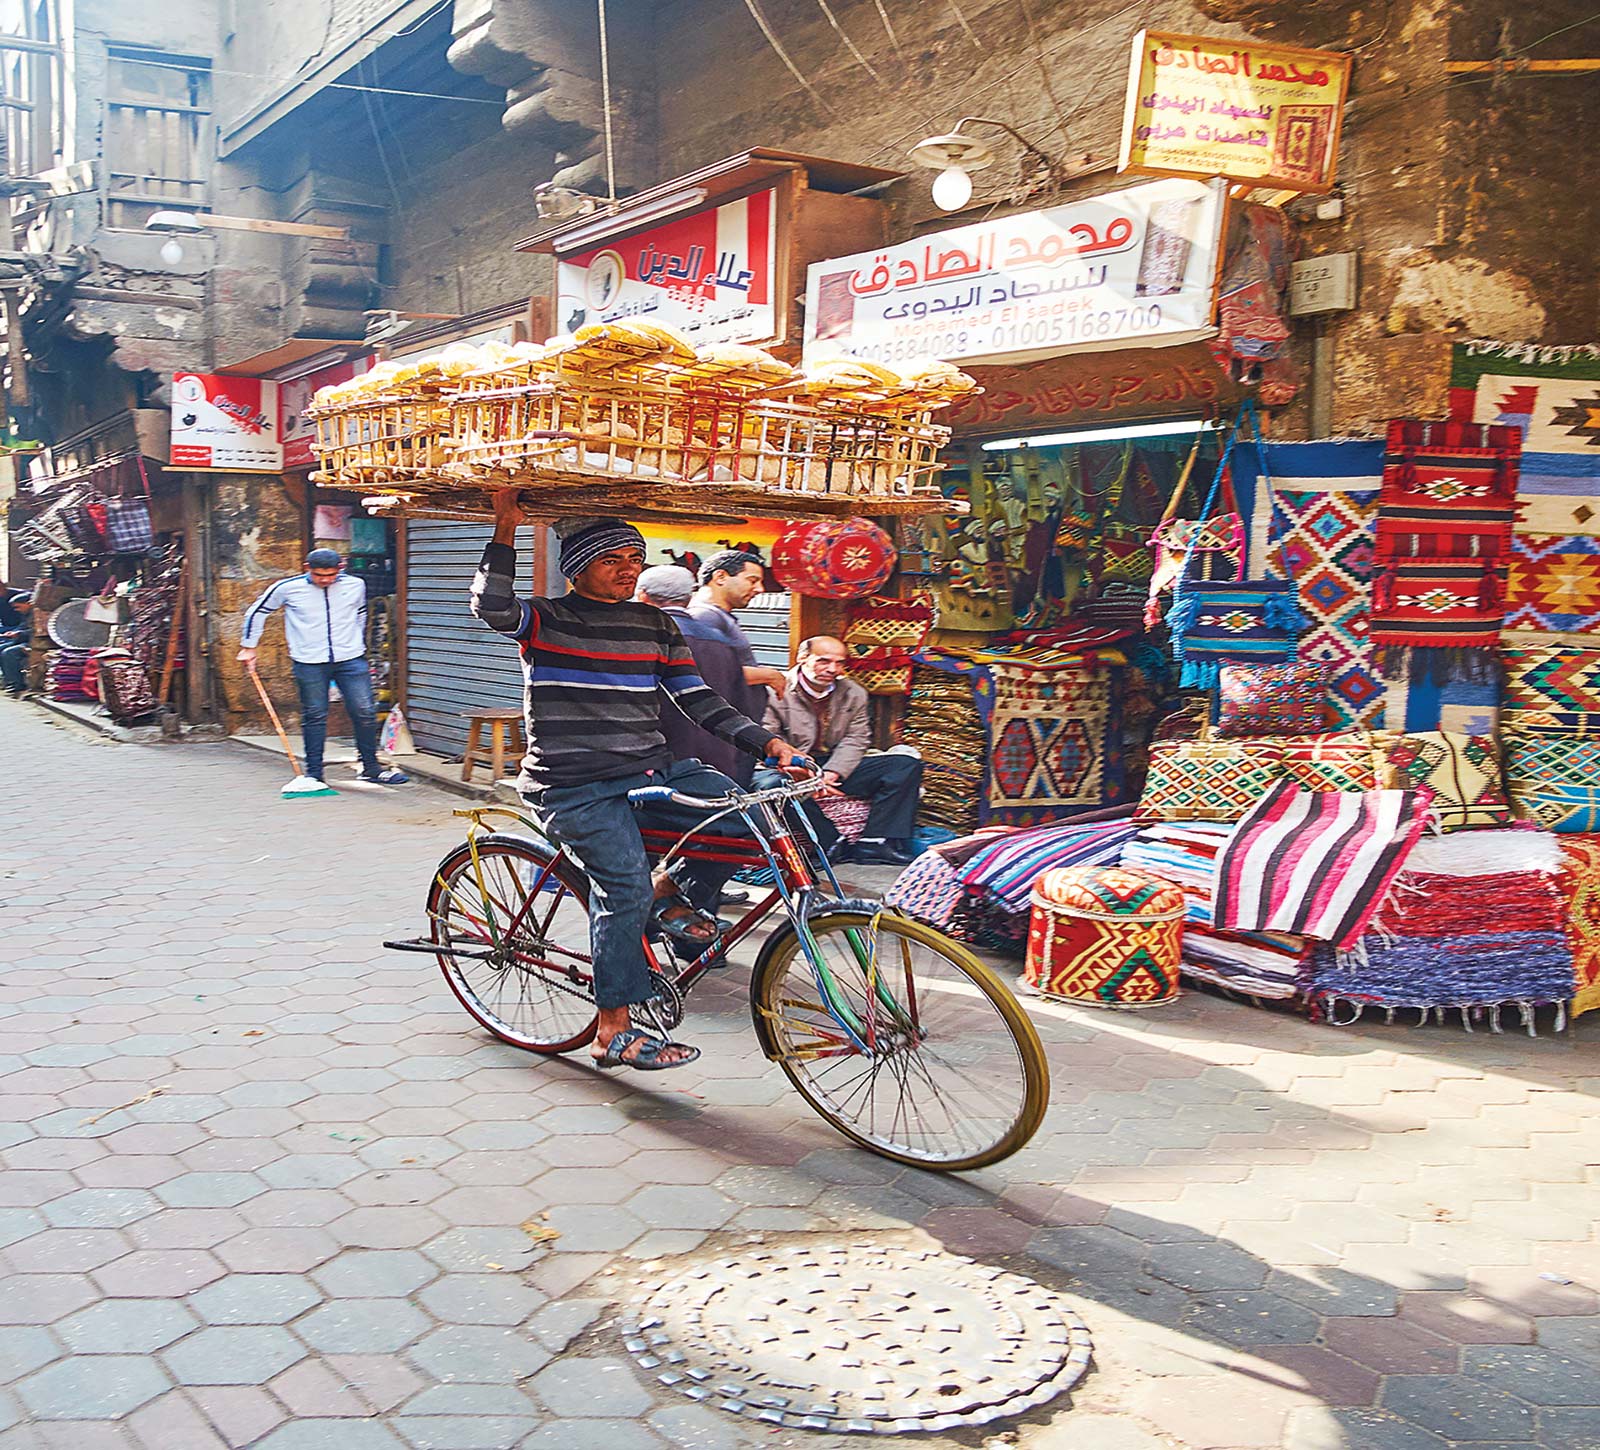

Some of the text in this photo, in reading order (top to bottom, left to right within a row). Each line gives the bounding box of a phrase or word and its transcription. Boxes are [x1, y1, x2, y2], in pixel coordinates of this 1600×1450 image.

[1150, 42, 1251, 78] الصادق
[1256, 63, 1330, 87] محمد
[637, 243, 755, 292] علاء الدين
[851, 217, 1133, 295] محمد الصادق
[882, 265, 1108, 321] للسجاد اليدوى
[894, 297, 1094, 338] Mohamed El sadek
[841, 331, 969, 364] 005684088
[992, 303, 1162, 349] 01005168700
